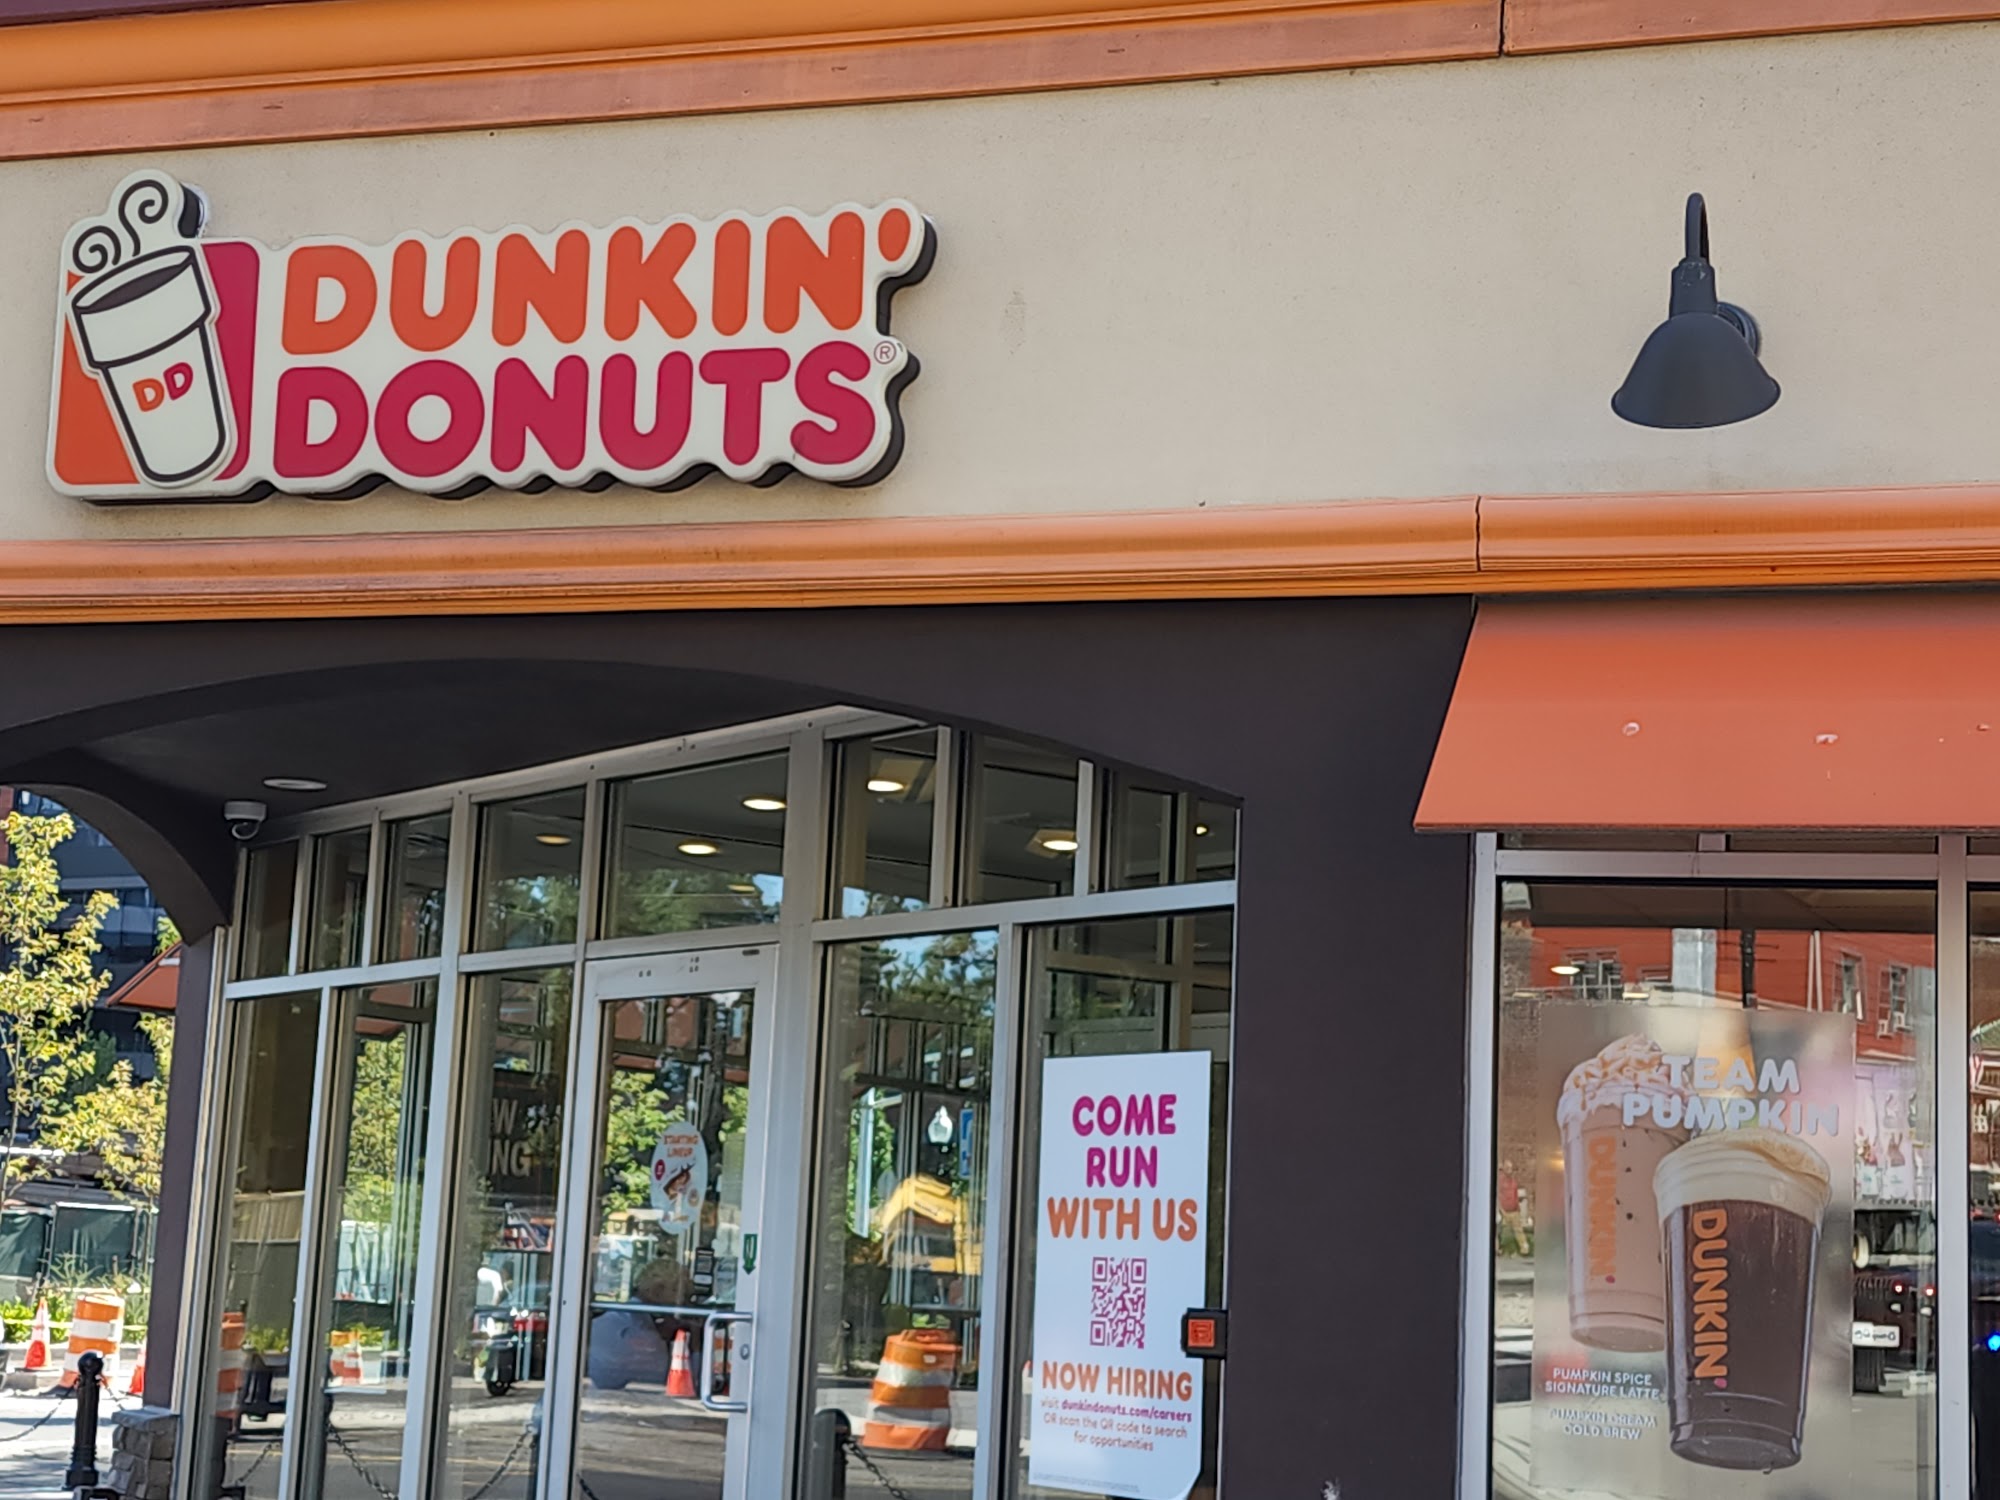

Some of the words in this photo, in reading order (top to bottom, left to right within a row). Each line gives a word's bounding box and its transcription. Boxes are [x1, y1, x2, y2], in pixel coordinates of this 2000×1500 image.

[282, 207, 910, 355] DUNKIN'
[273, 340, 877, 478] DONUTS
[1661, 1056, 1801, 1094] TEAM
[1072, 1093, 1177, 1137] COME
[1623, 1092, 1839, 1136] PUMPKIN
[1086, 1145, 1158, 1188] RUN
[1047, 1196, 1141, 1240] WITH
[1153, 1197, 1198, 1242] US
[1042, 1360, 1101, 1393] NOW
[1107, 1365, 1192, 1402] HIRING
[1545, 1380, 1617, 1397] SIGNATURE
[1620, 1386, 1660, 1400] LATTE
[1553, 1367, 1612, 1383] PUMPKIN
[1614, 1371, 1652, 1387] SPICE
[1044, 1412, 1057, 1424] OR
[1059, 1416, 1080, 1427] scan
[1082, 1415, 1097, 1429] the
[1100, 1416, 1114, 1430] QR
[1116, 1419, 1139, 1434] code
[1142, 1423, 1152, 1435] to
[1154, 1425, 1187, 1438] search
[1061, 1398, 1192, 1423] dunkindonuts.com/careers
[1074, 1430, 1088, 1442] for
[1090, 1435, 1153, 1451] opportunities
[1563, 1422, 1602, 1437] COLD
[1603, 1425, 1642, 1440] BREW
